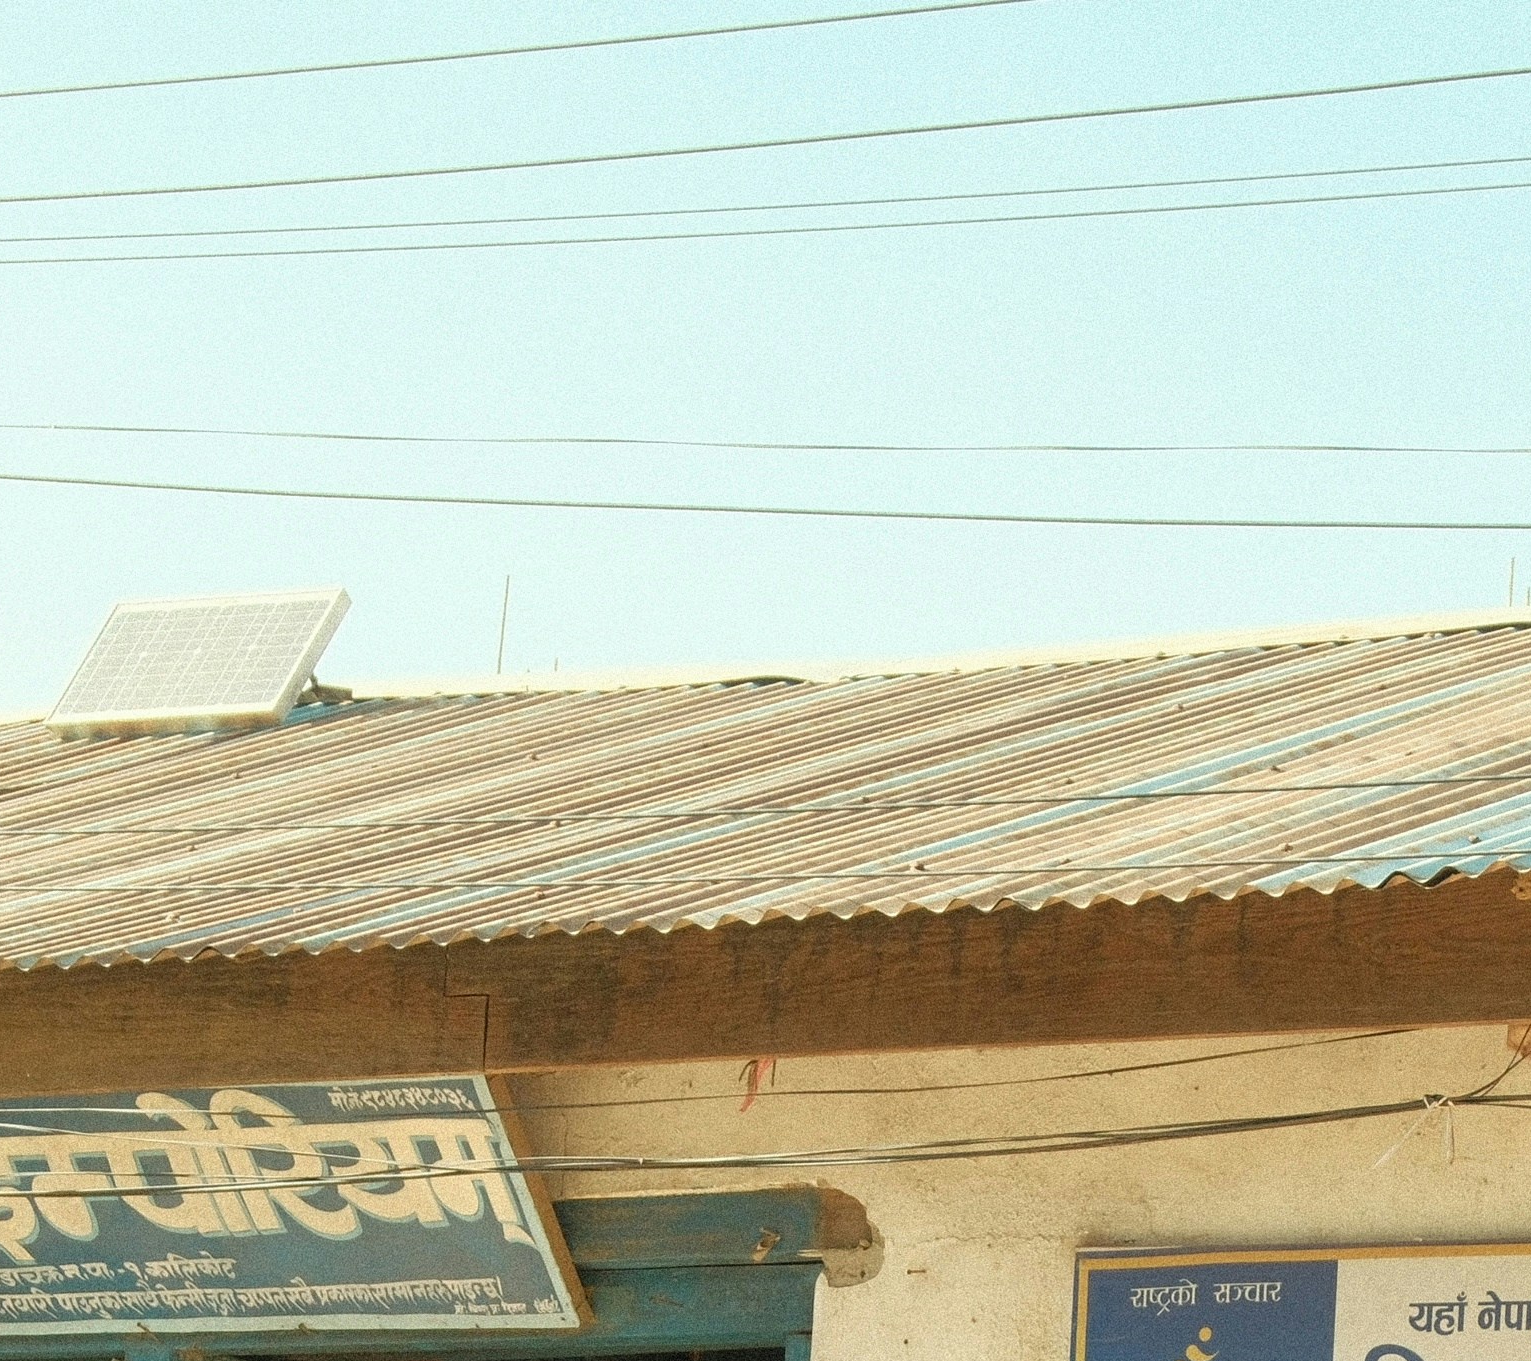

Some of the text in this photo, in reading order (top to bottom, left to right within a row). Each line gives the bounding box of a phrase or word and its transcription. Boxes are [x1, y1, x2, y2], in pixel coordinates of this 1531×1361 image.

[1130, 1279, 1282, 1315] राष्ट्रको सञ्चार
[1408, 1290, 1467, 1337] यहाँ
